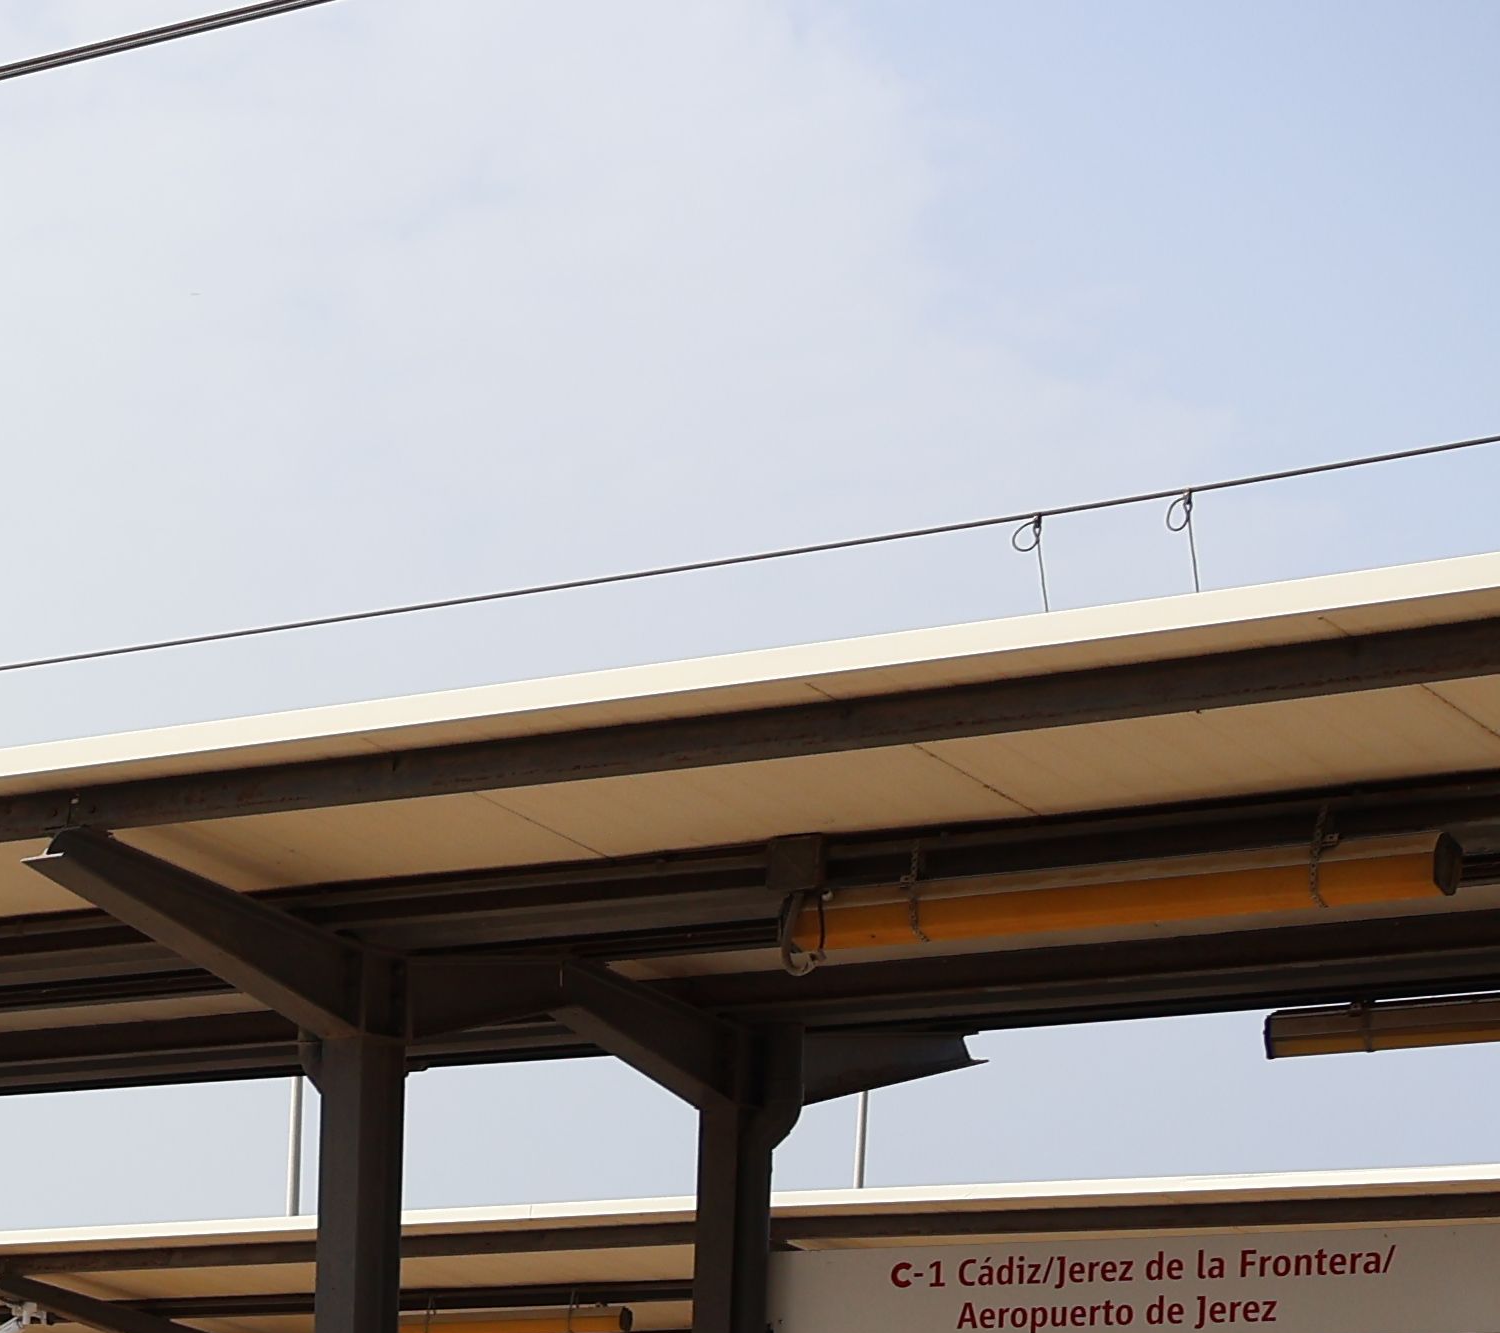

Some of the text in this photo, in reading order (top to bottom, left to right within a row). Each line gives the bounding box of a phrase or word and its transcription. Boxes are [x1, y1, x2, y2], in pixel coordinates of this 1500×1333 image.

[891, 1244, 1396, 1288] C-1 Cádiz/Jerez de la Frontera/
[1145, 1295, 1184, 1324] de
[1195, 1295, 1277, 1328] Jerez
